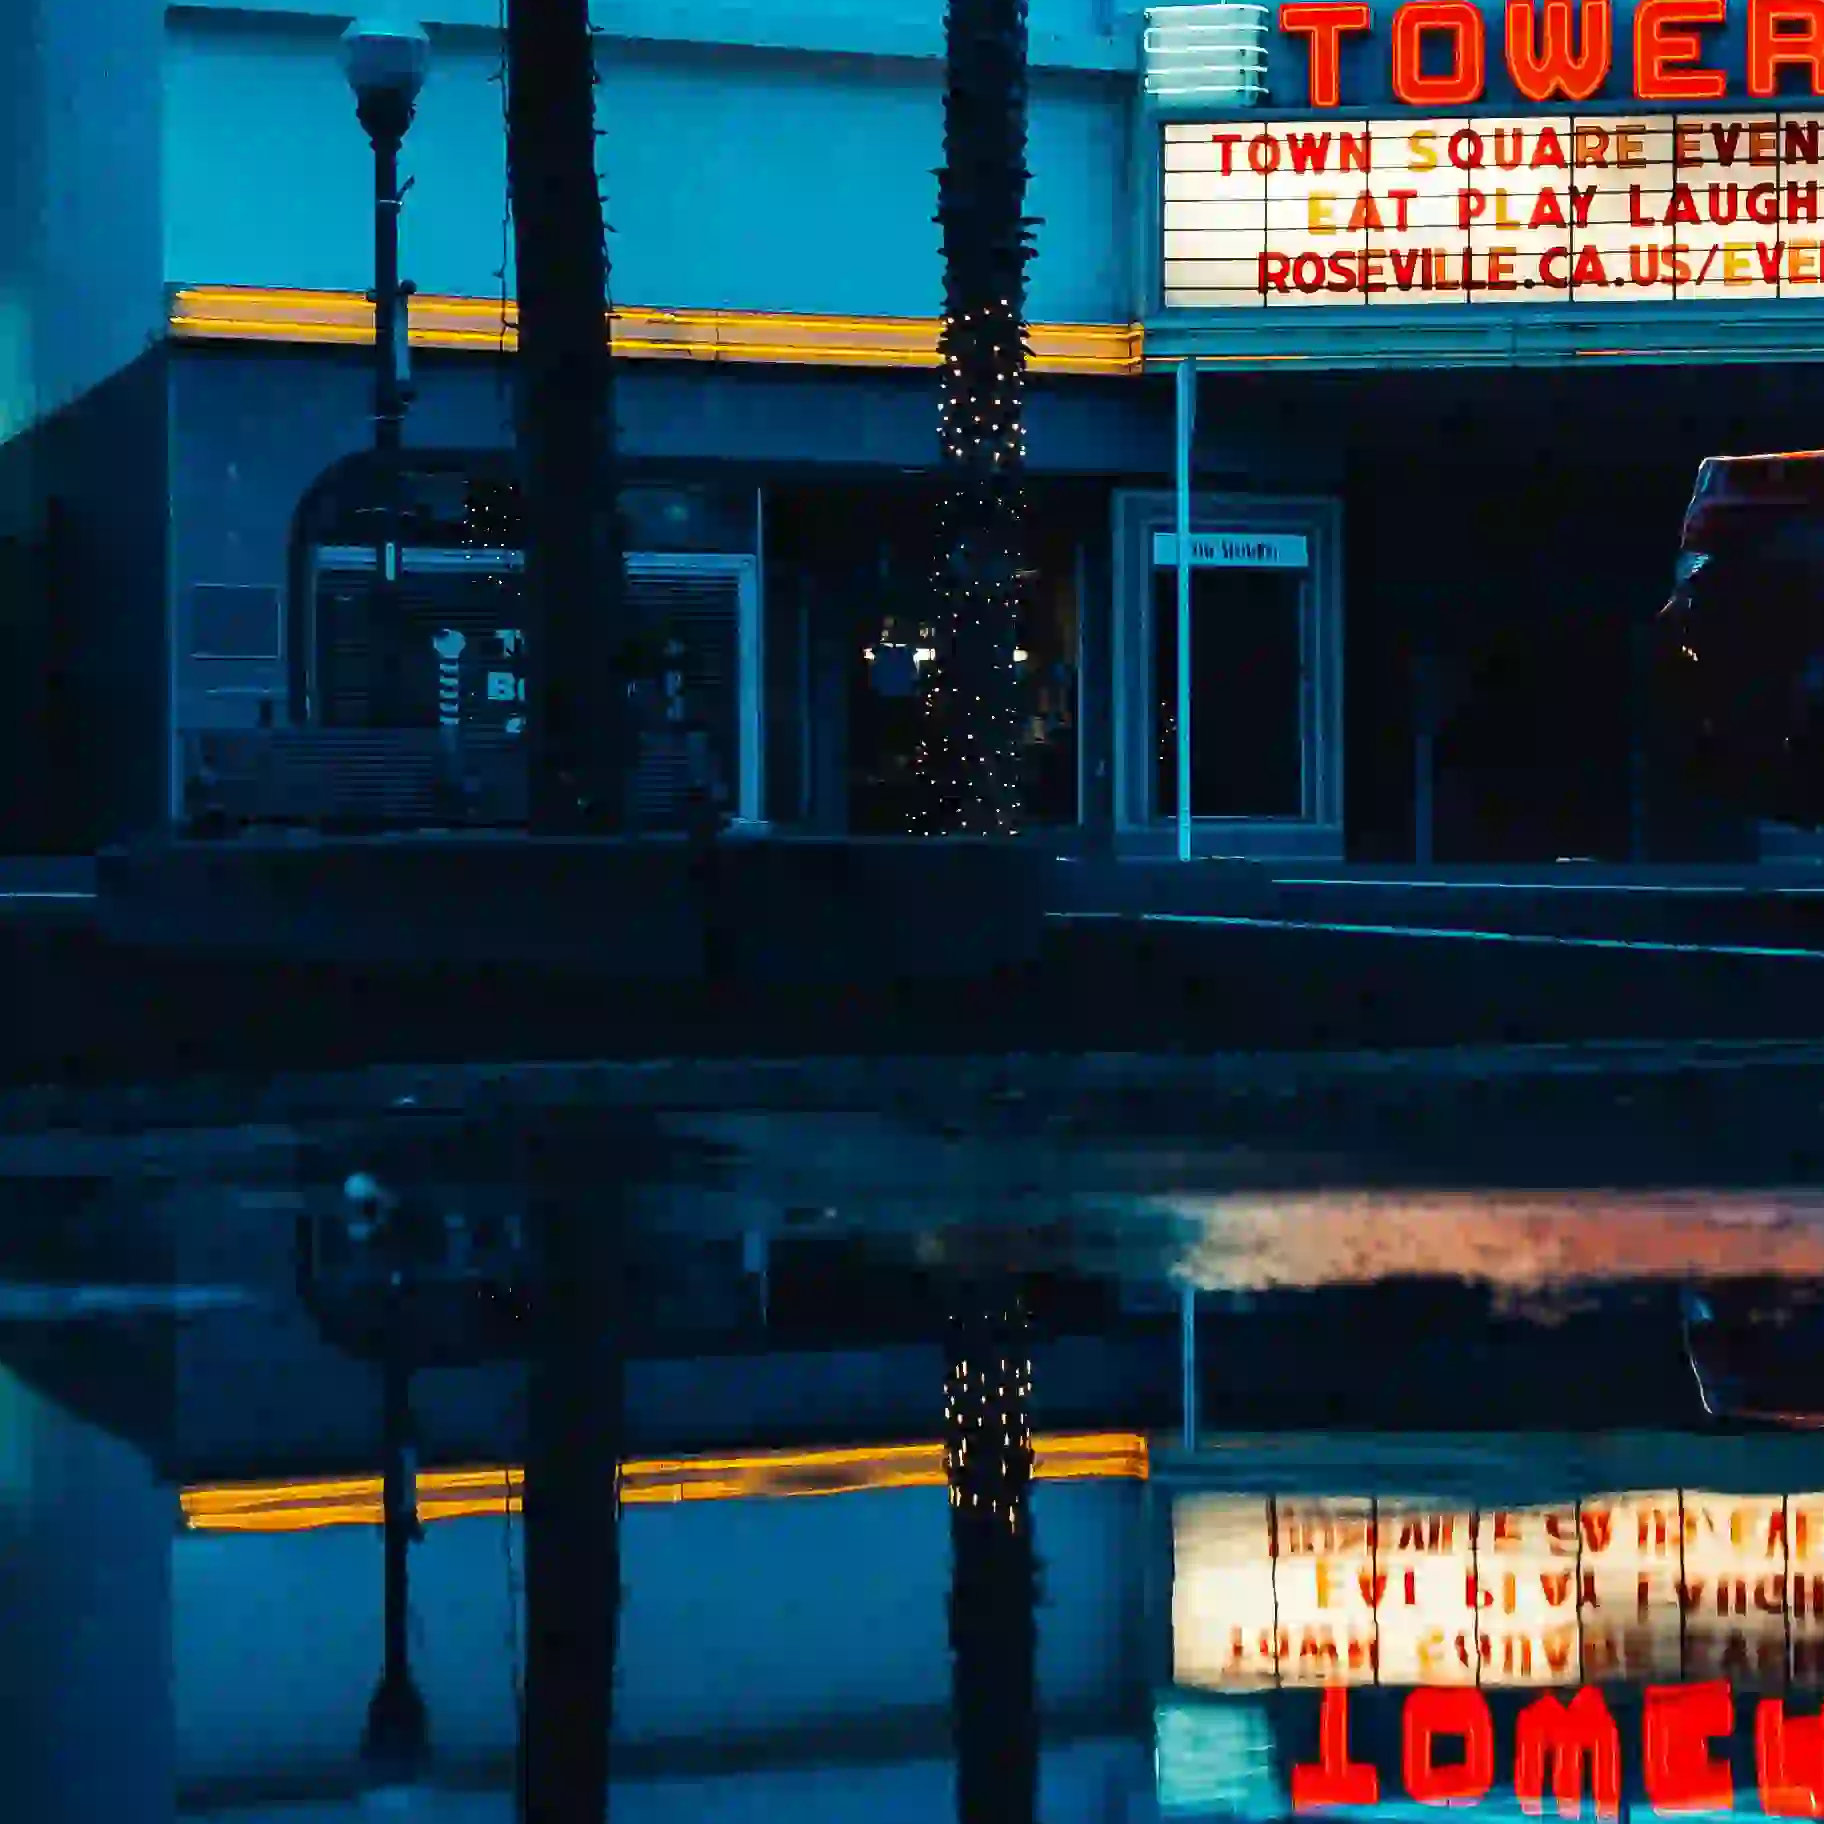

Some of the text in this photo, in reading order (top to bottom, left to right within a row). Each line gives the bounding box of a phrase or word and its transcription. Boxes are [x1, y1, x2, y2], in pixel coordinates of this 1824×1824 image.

[1212, 131, 1372, 176] TOWN
[1408, 124, 1646, 172] SQUARE
[1308, 180, 1818, 235] EAT PLAY LAUGH
